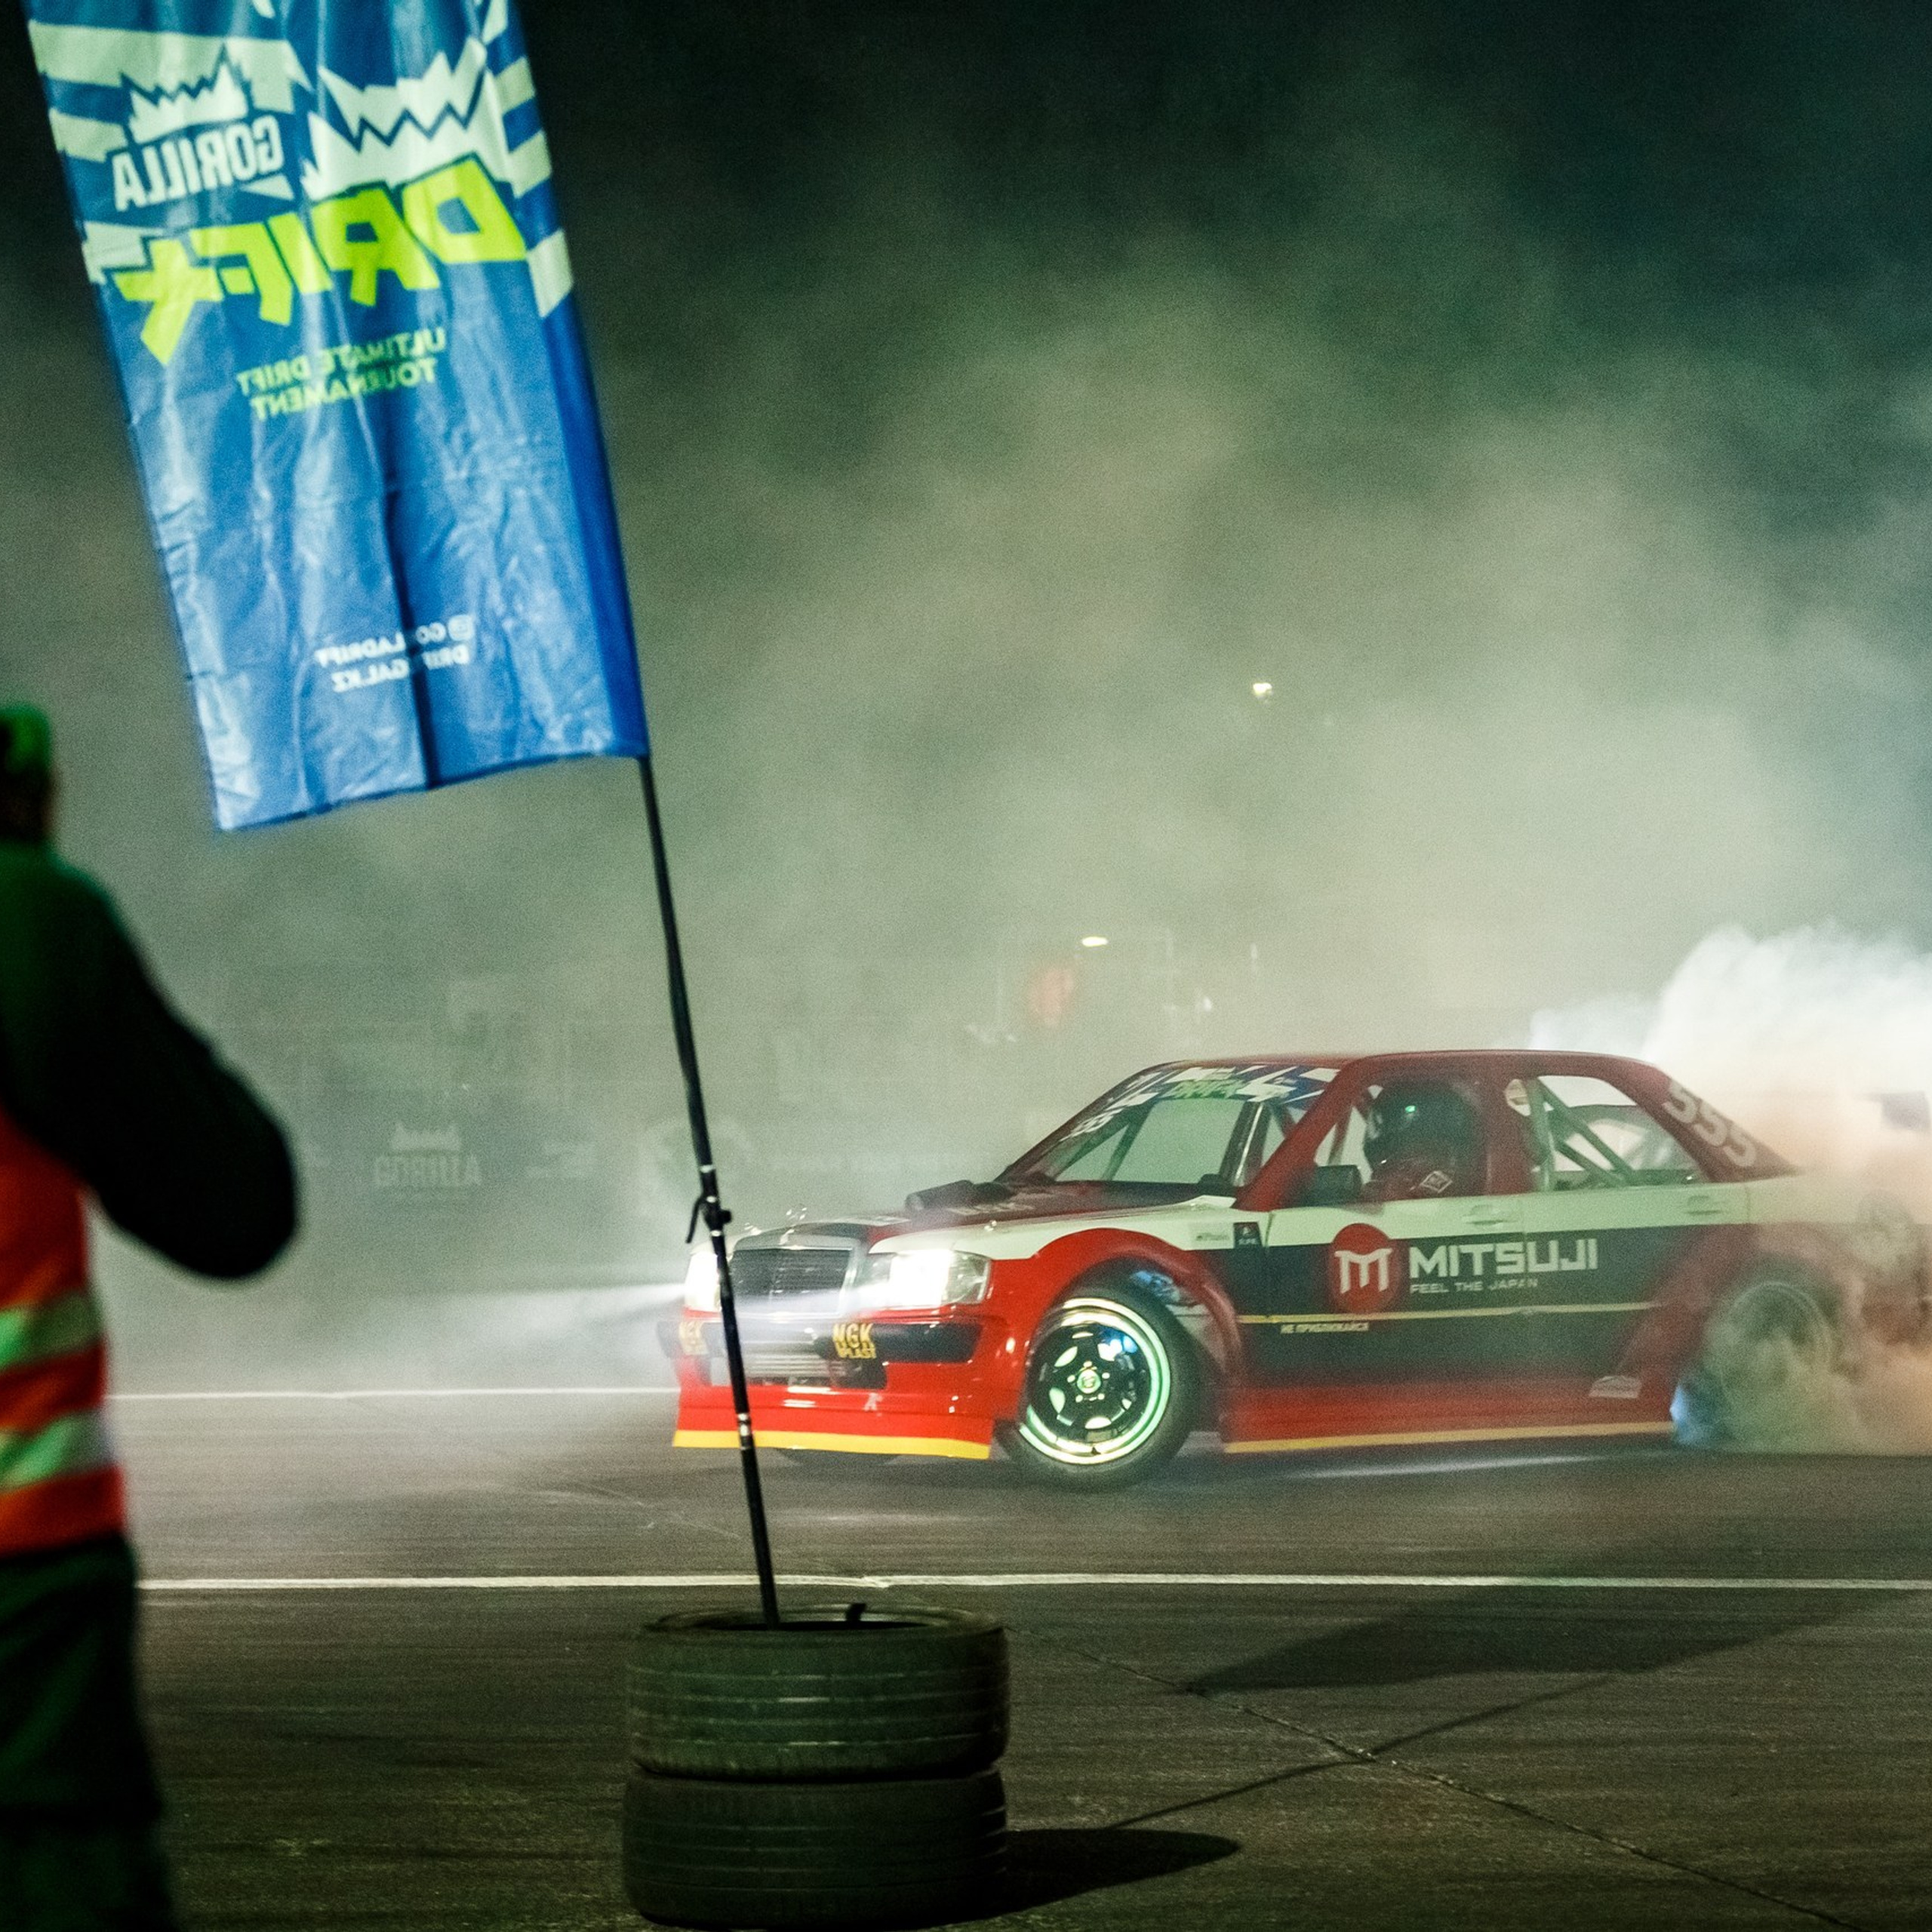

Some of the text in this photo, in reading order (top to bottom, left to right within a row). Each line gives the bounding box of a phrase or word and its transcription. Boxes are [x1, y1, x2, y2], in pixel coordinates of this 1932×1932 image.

[1661, 1078, 1758, 1168] 555
[1408, 1238, 1598, 1279] MITSUJI
[1410, 1278, 1539, 1294] FEEL THE JAPAN
